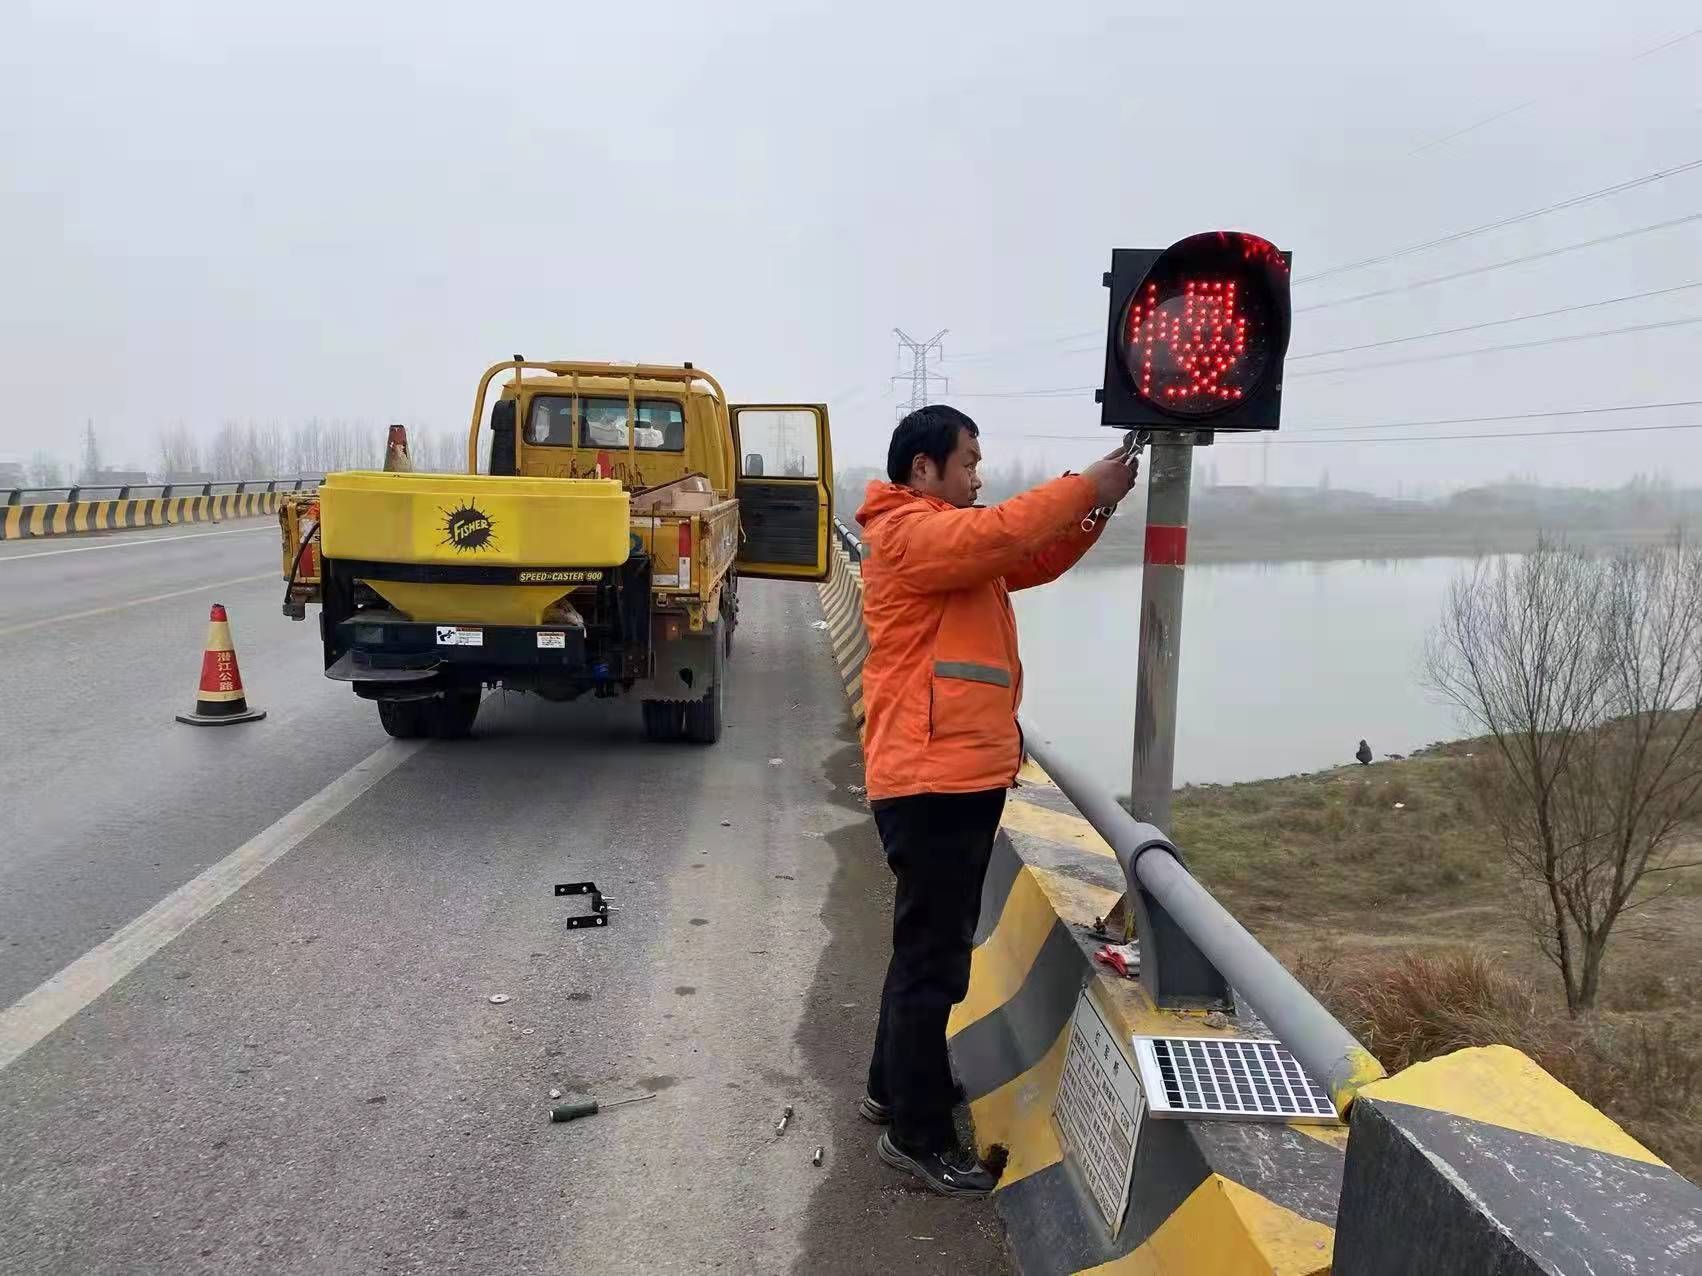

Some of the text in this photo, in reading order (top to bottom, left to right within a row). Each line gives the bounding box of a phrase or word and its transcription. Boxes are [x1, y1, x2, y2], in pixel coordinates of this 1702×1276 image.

[1132, 281, 1246, 397] 慢
[453, 519, 489, 542] FISHER
[587, 571, 603, 581] 900
[217, 651, 233, 691] 潜江公路
